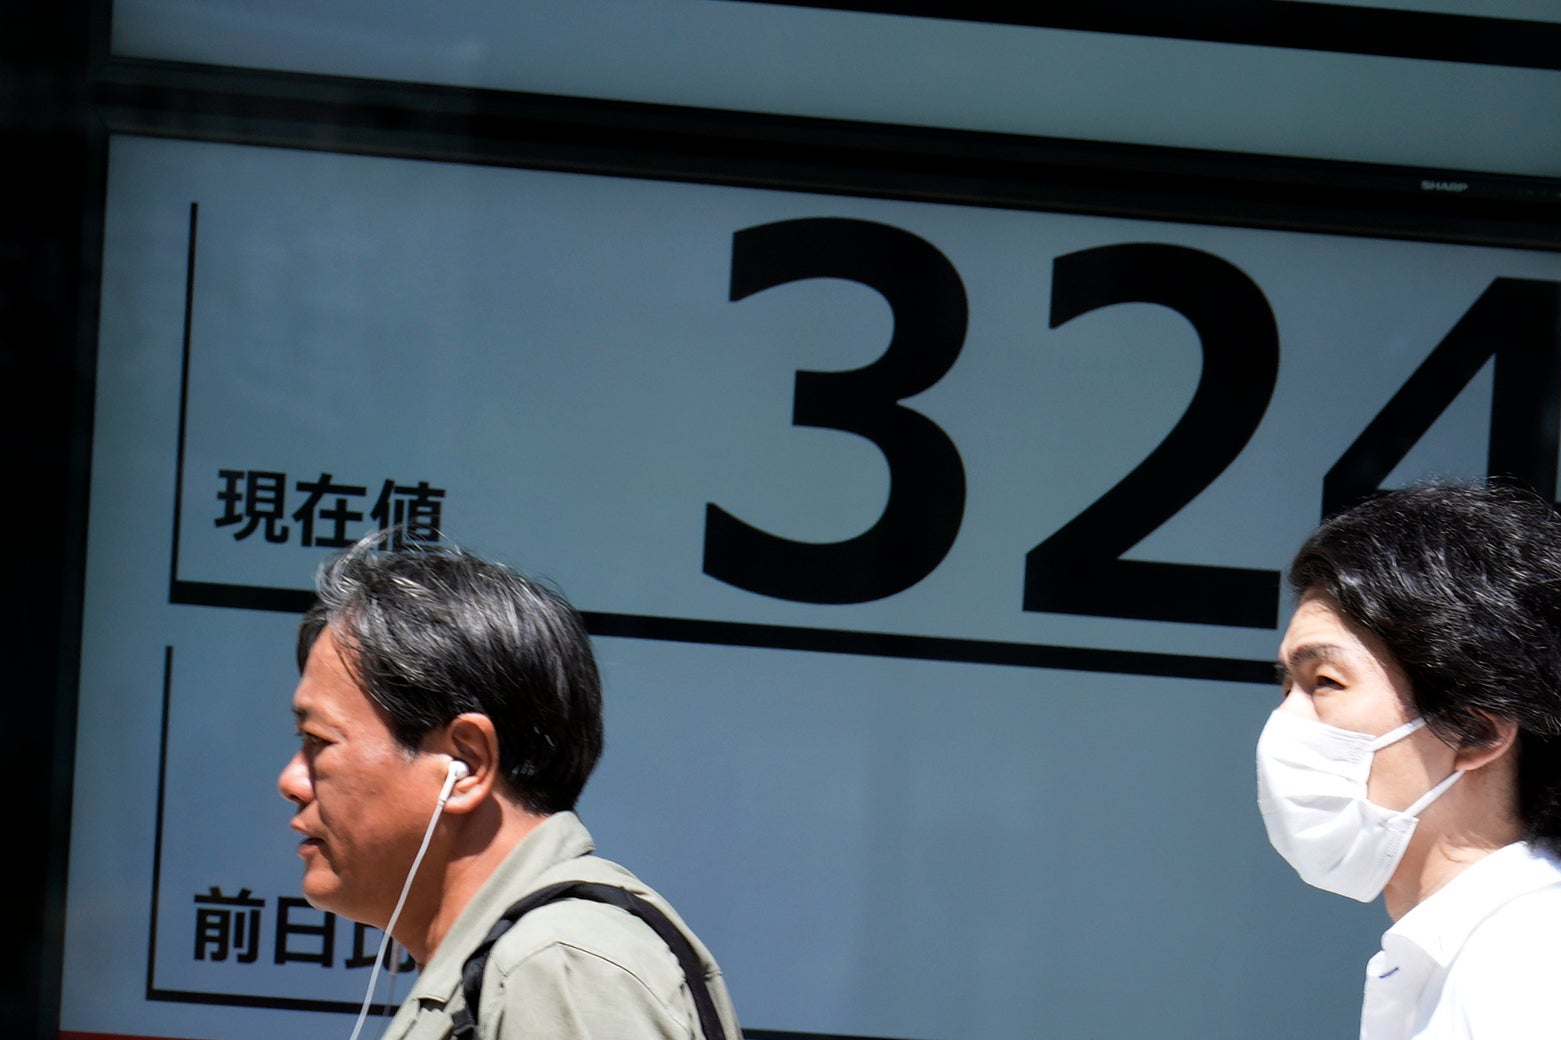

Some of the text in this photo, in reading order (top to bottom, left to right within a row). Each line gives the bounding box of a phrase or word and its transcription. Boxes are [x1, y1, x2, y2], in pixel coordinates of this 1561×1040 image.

[1421, 179, 1469, 193] SHARP
[213, 468, 446, 553] 現在値
